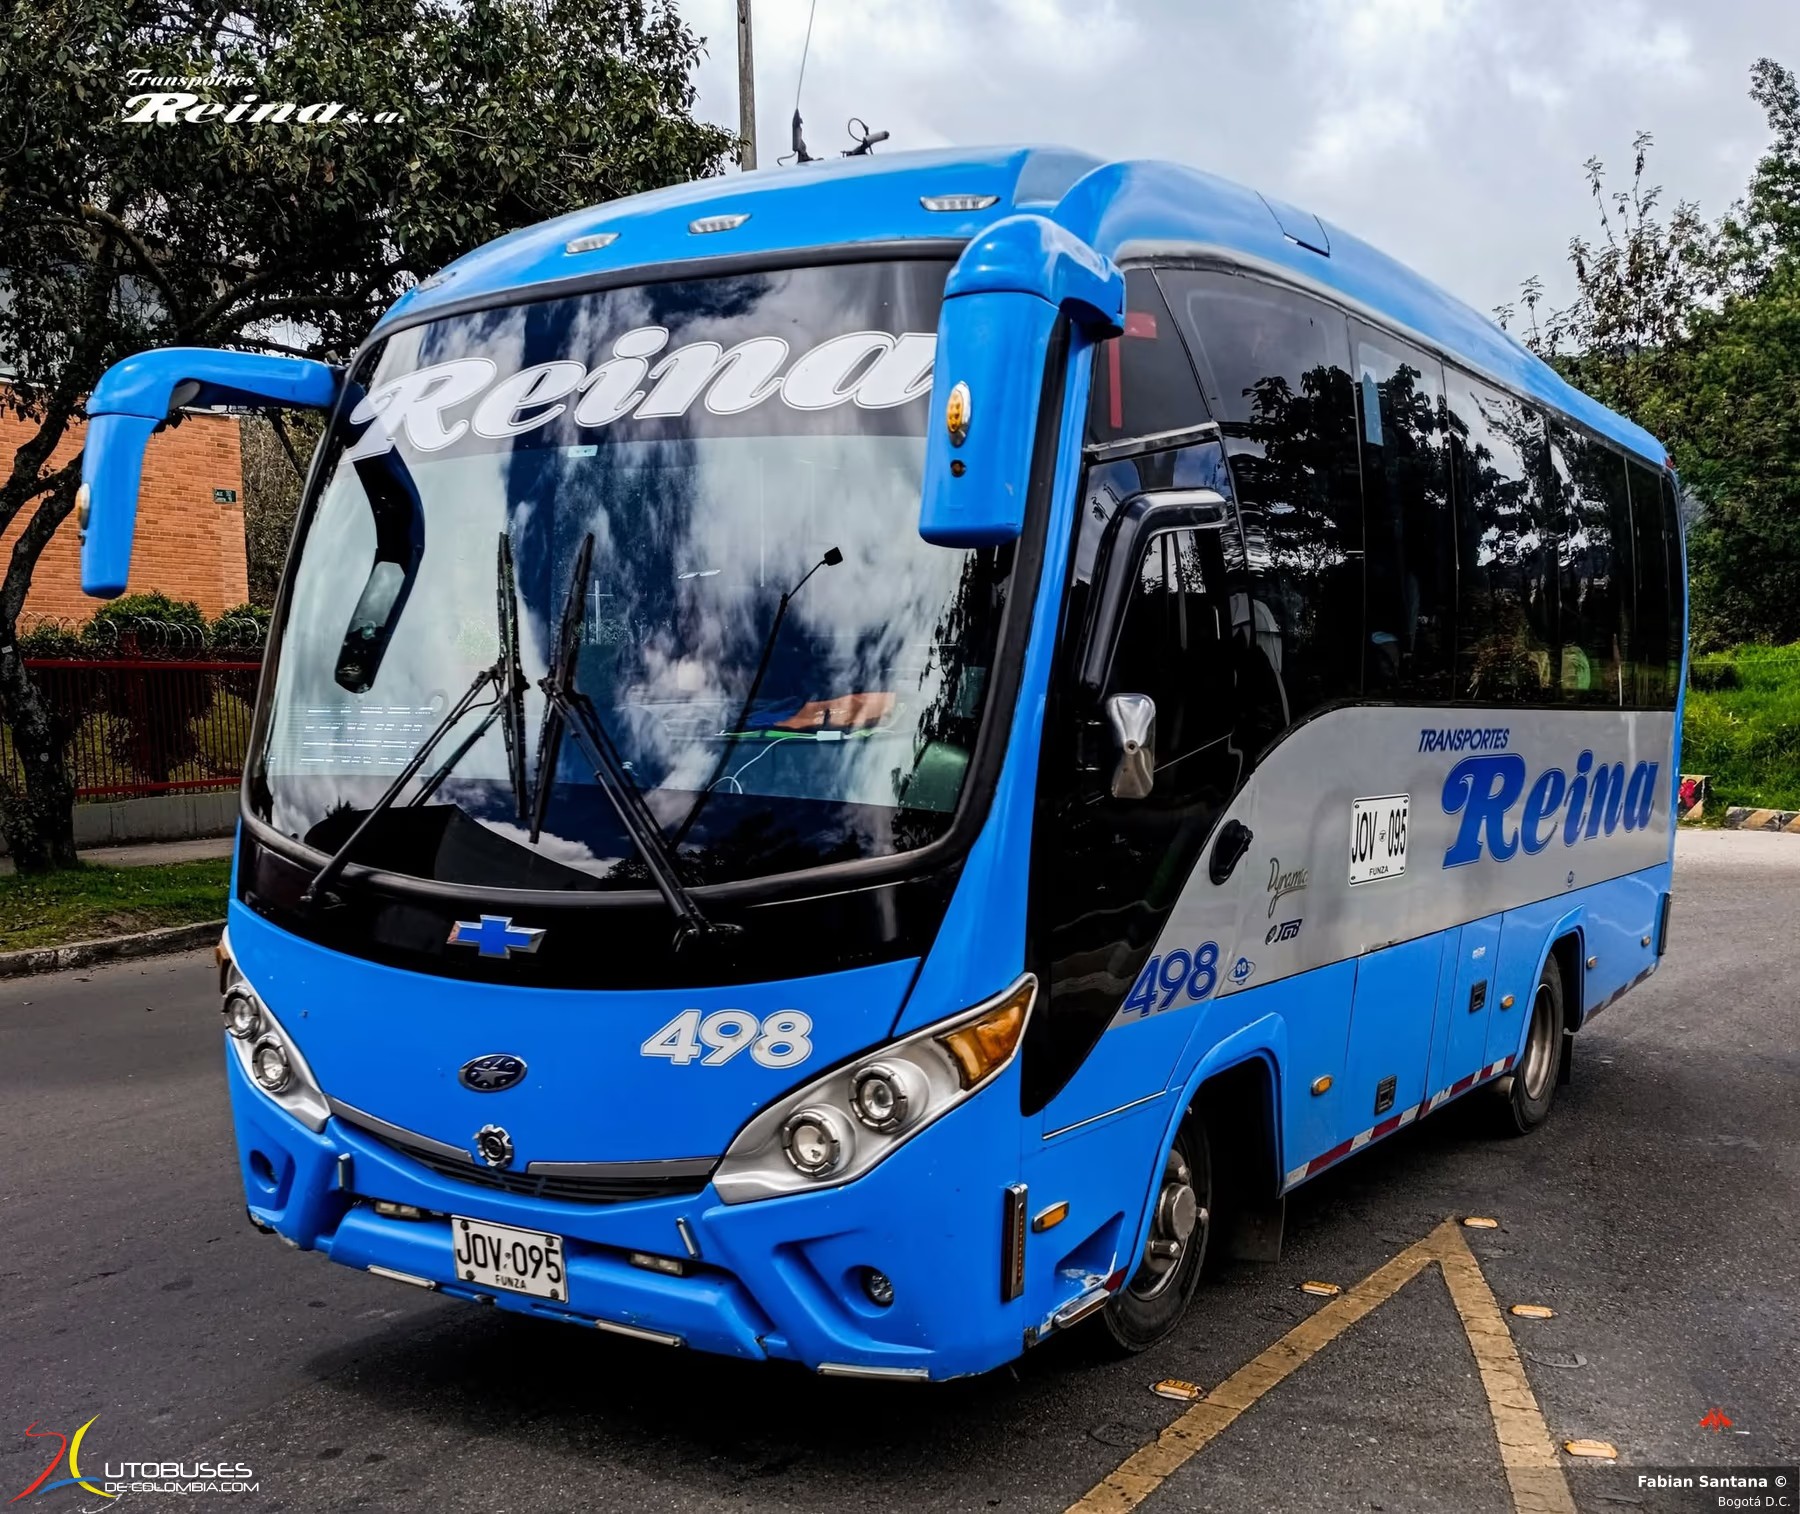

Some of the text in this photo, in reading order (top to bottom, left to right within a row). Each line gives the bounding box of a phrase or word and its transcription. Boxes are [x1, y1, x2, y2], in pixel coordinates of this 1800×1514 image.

[339, 325, 938, 465] Reina
[1418, 728, 1510, 753] TRANSPORTES
[1441, 749, 1660, 870] Reina
[1369, 865, 1389, 876] FUNZA
[1122, 941, 1220, 1018] 498
[640, 1008, 813, 1069] 498
[495, 1274, 527, 1290] FUNZA
